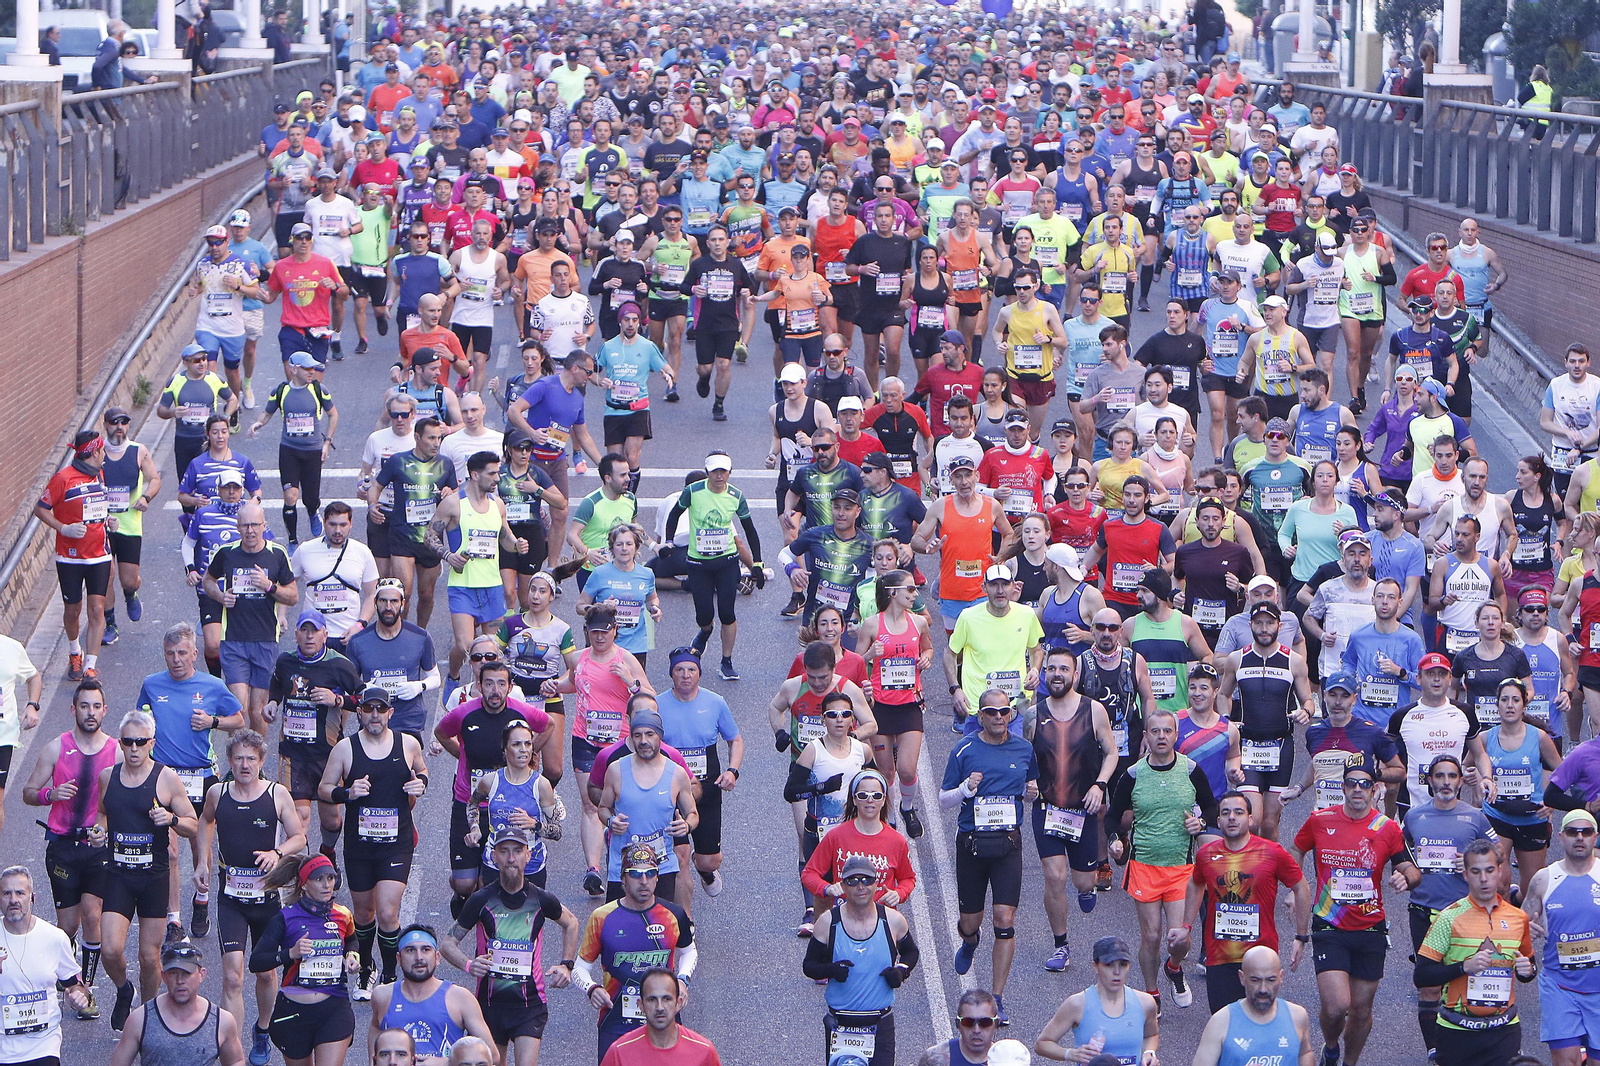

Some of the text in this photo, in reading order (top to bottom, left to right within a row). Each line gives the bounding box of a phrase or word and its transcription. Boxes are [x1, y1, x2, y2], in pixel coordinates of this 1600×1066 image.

[285, 280, 318, 289] MADRID
[814, 558, 847, 572] Electrofil
[1429, 730, 1448, 738] edp
[1568, 932, 1594, 940] ZURICH
[316, 948, 340, 956] ZURICH
[18, 993, 42, 1002] ZURICH
[1488, 1015, 1509, 1028] MAX
